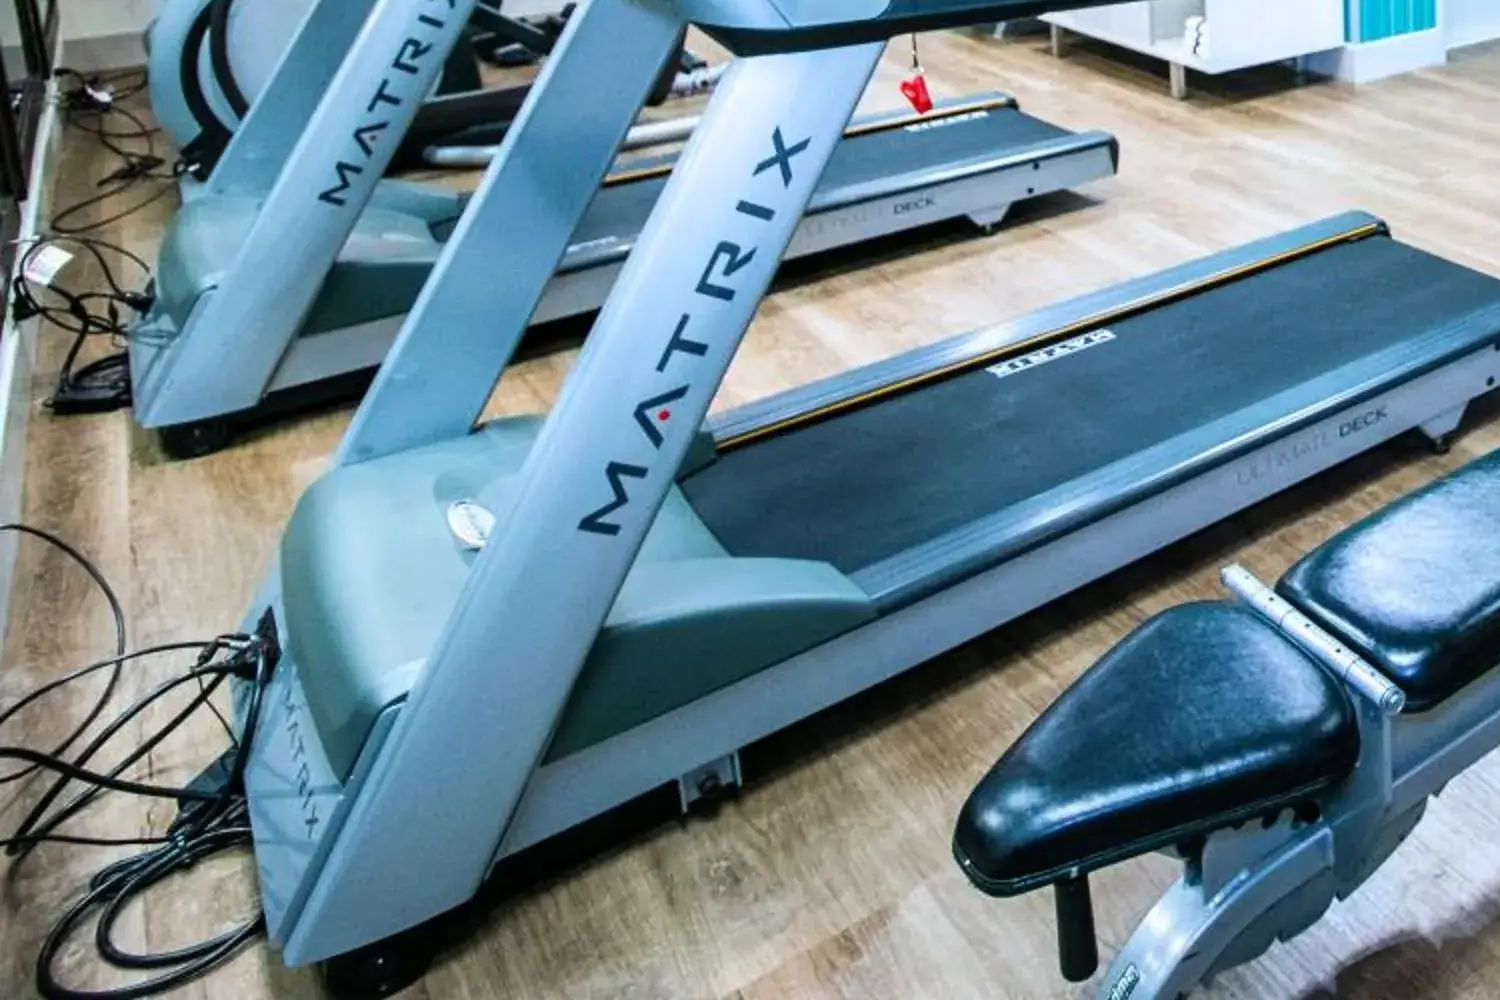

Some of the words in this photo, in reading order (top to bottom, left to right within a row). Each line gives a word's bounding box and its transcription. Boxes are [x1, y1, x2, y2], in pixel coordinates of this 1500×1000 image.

[893, 196, 935, 214] DECK
[577, 125, 811, 536] MATRIX
[1338, 405, 1387, 438] DECK
